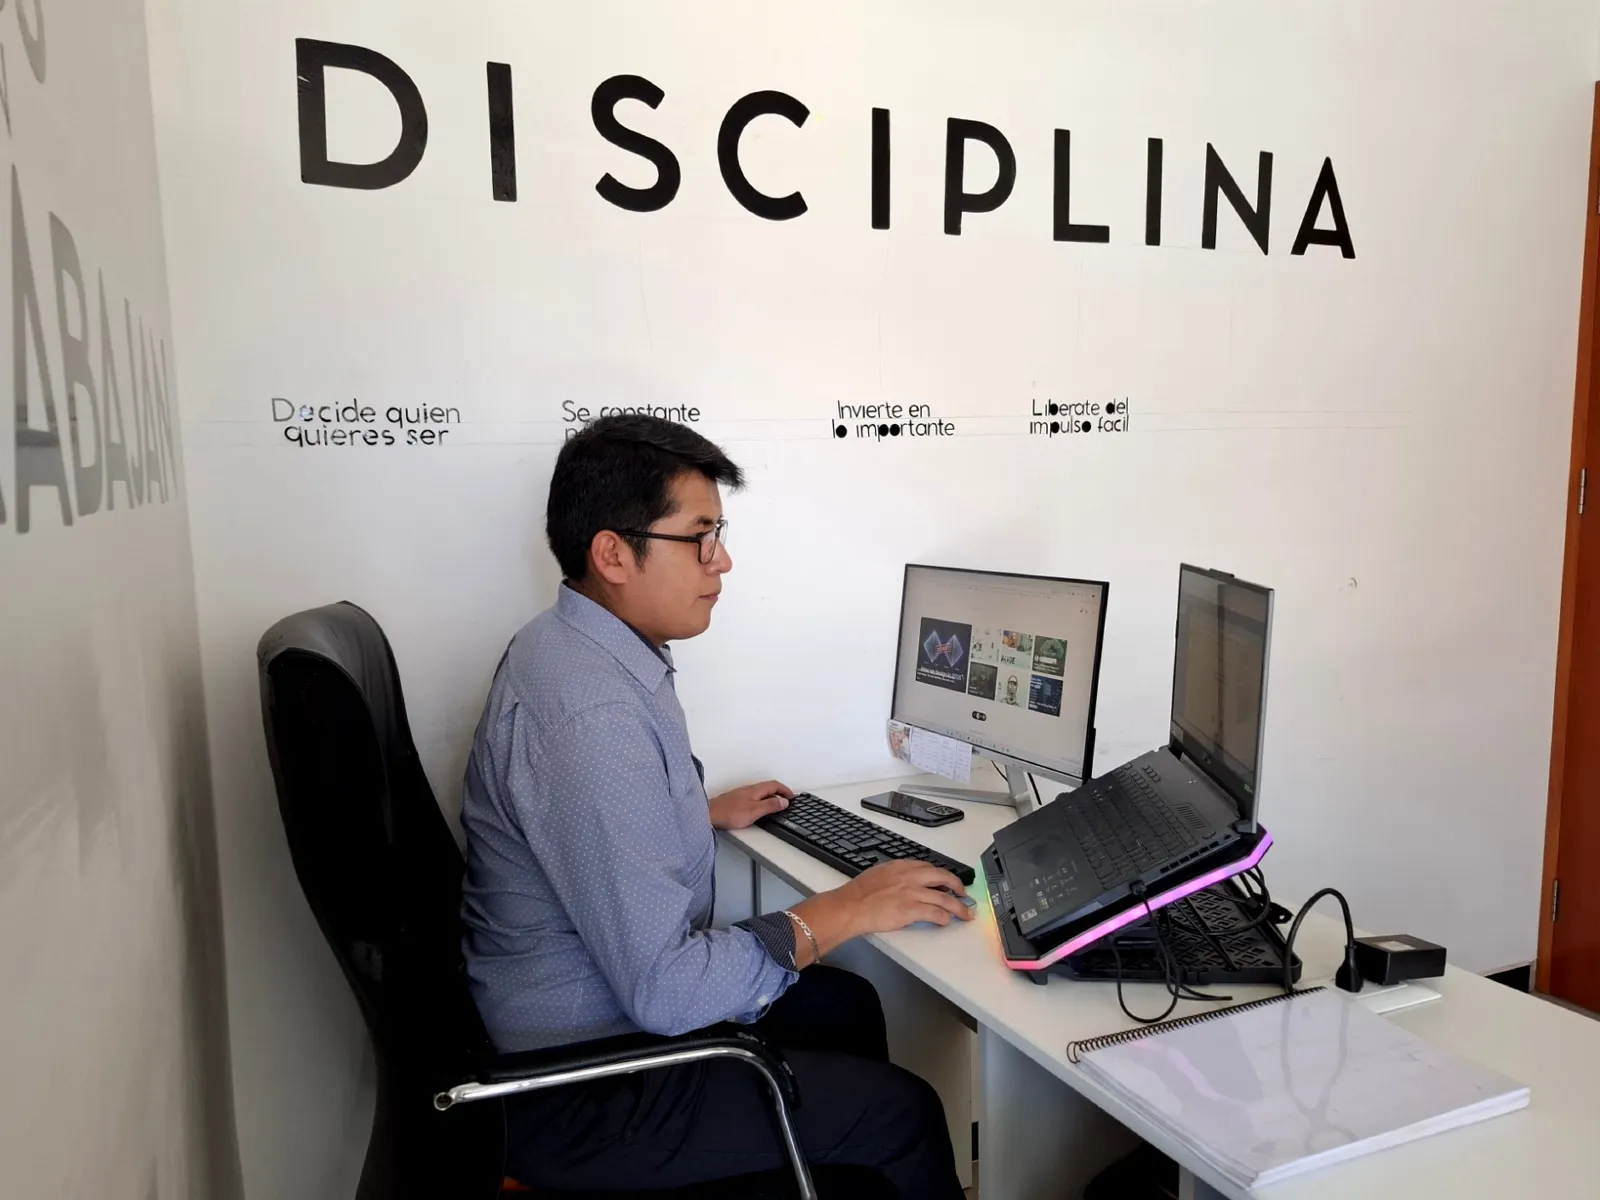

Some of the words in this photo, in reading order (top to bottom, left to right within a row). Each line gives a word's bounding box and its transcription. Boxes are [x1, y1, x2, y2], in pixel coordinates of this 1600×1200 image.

[295, 37, 1356, 260] DISCIPLINA
[271, 397, 376, 423] Decide
[386, 402, 461, 429] quien
[562, 399, 590, 422] Se
[837, 399, 903, 419] Invierte
[908, 404, 931, 418] en
[1032, 398, 1101, 417] Liberate
[1105, 396, 1129, 415] del
[284, 425, 395, 448] quieres
[406, 428, 449, 446] ser
[832, 418, 848, 439] lo
[856, 418, 955, 442] importante
[1030, 415, 1092, 438] impulso
[1097, 414, 1129, 432] facil
